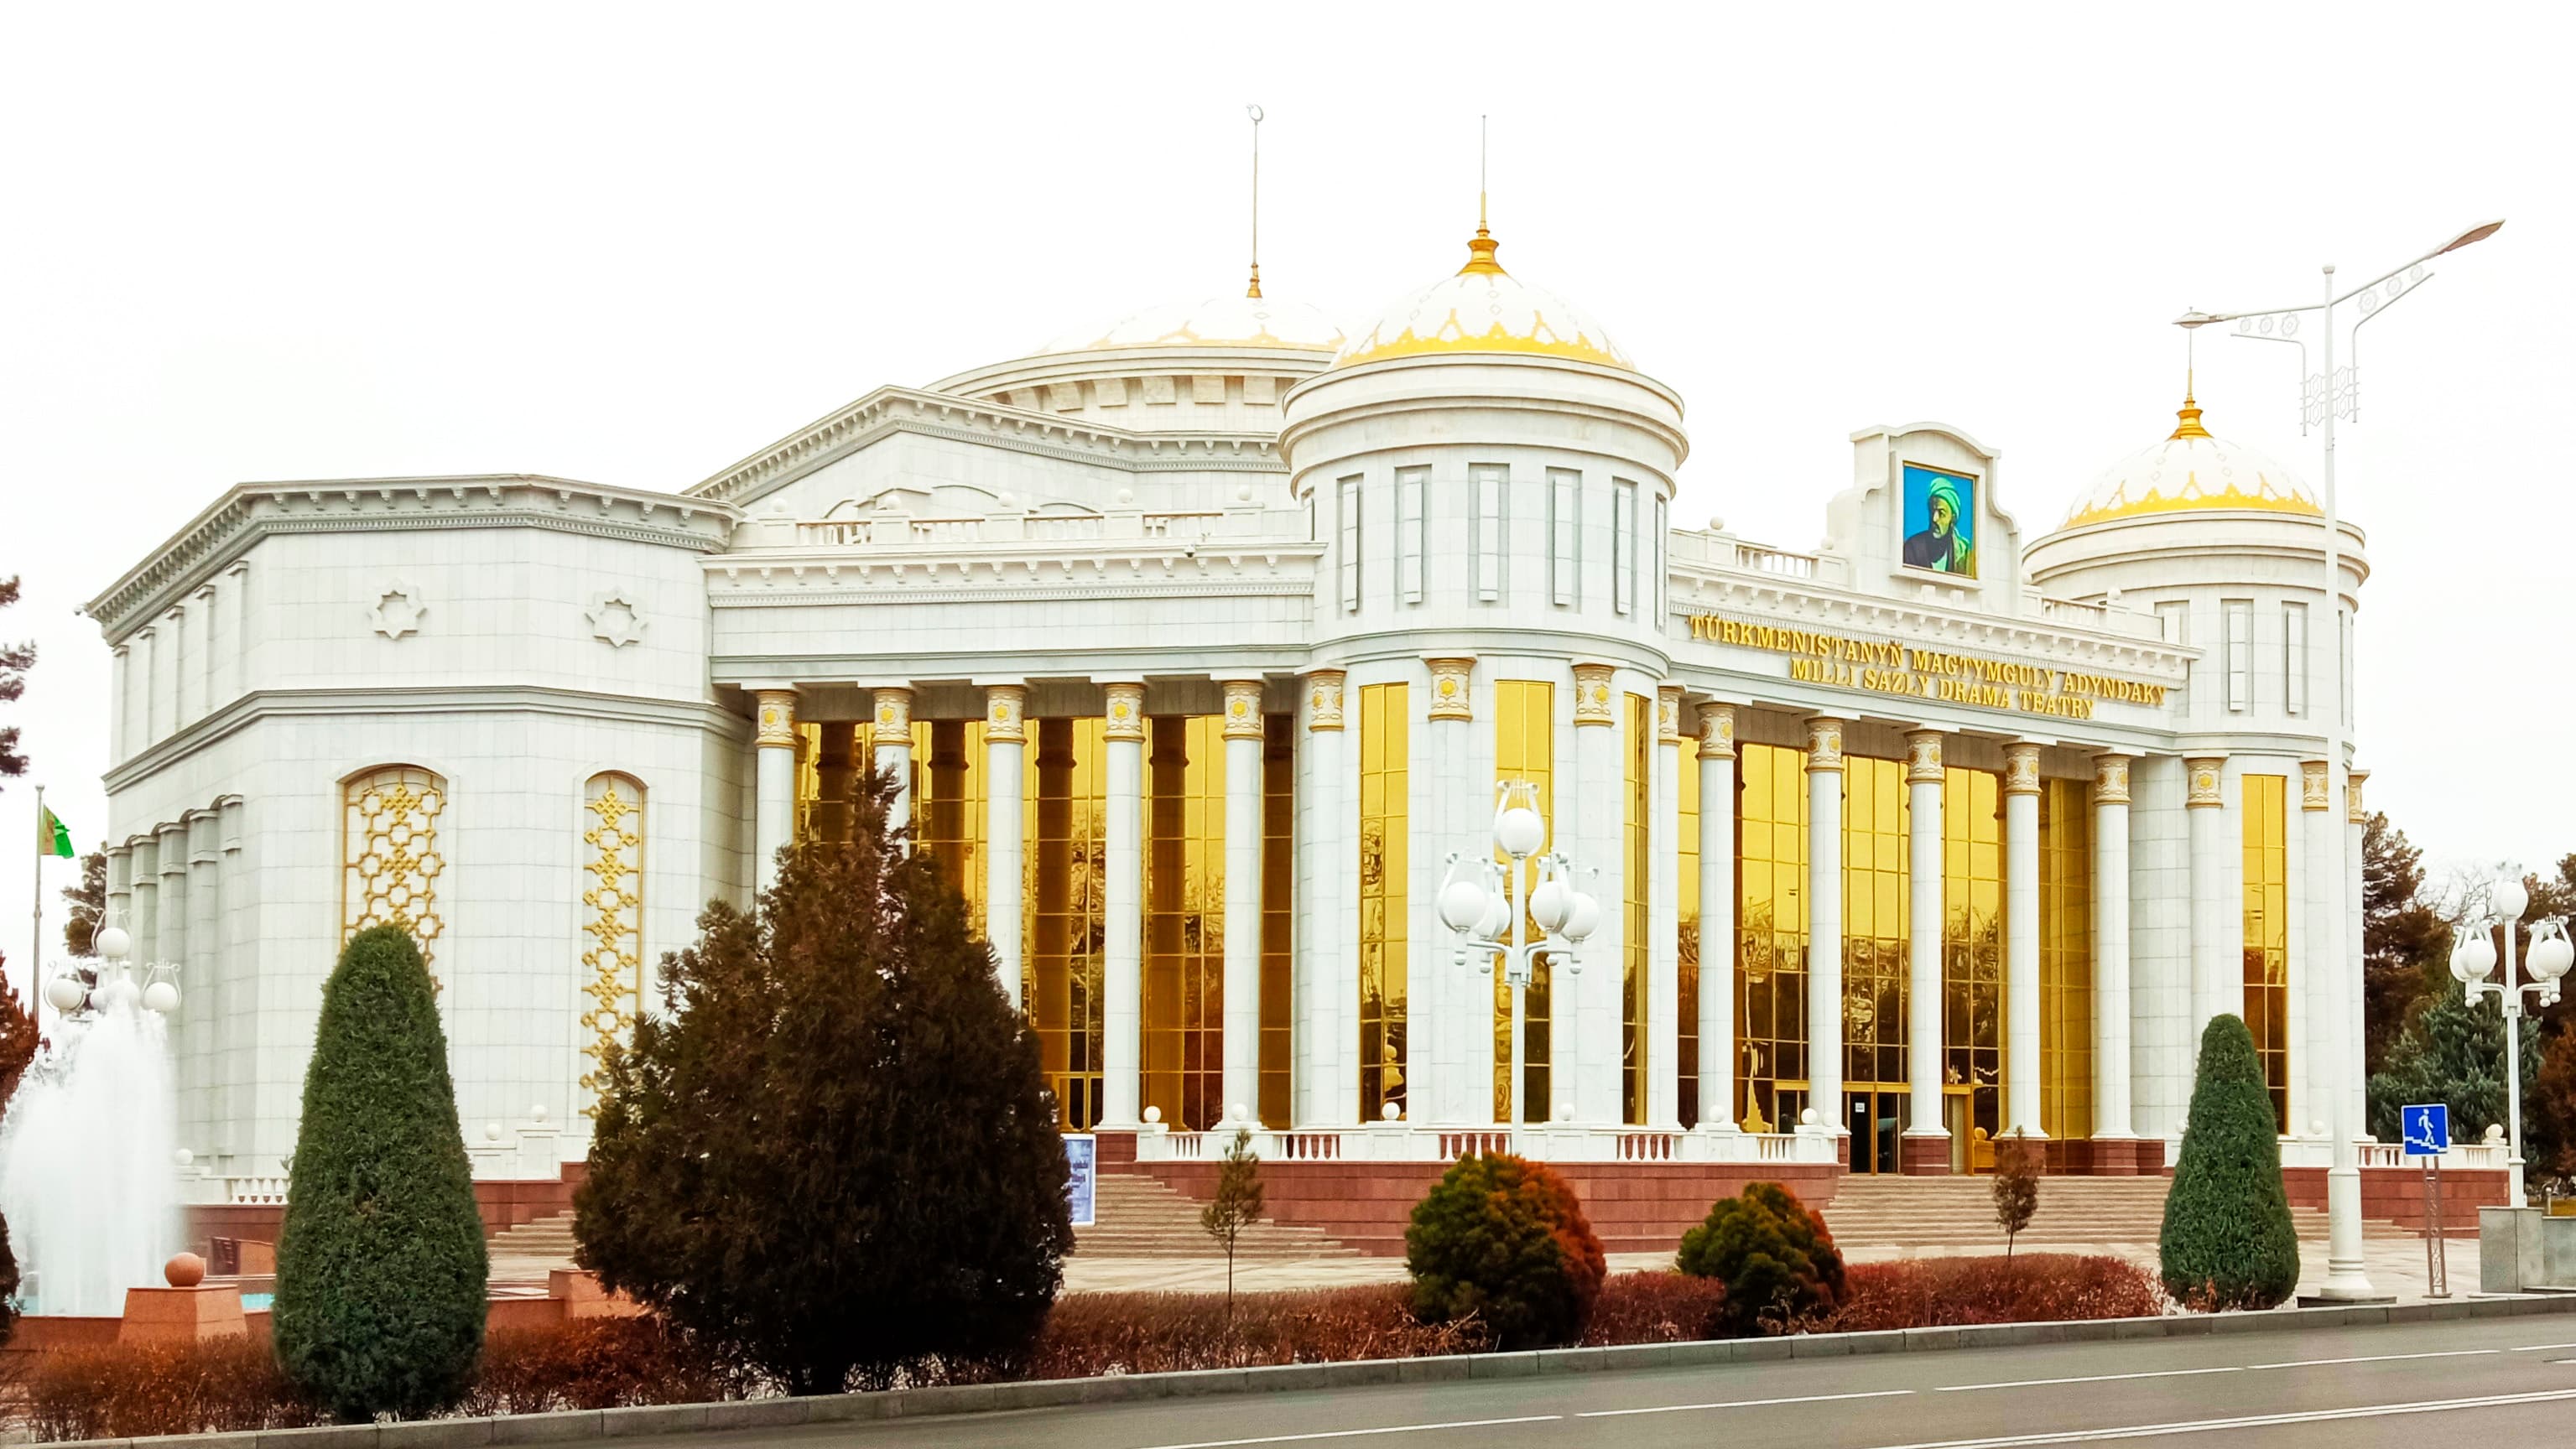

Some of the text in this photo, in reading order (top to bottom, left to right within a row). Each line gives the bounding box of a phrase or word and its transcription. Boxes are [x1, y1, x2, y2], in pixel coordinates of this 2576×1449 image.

[1791, 657, 2095, 720] MILLI SAZLY DRAMA TEATRY
[1912, 649, 2055, 690] MAGTYMGULY
[2063, 671, 2167, 706] ADYNDAKY
